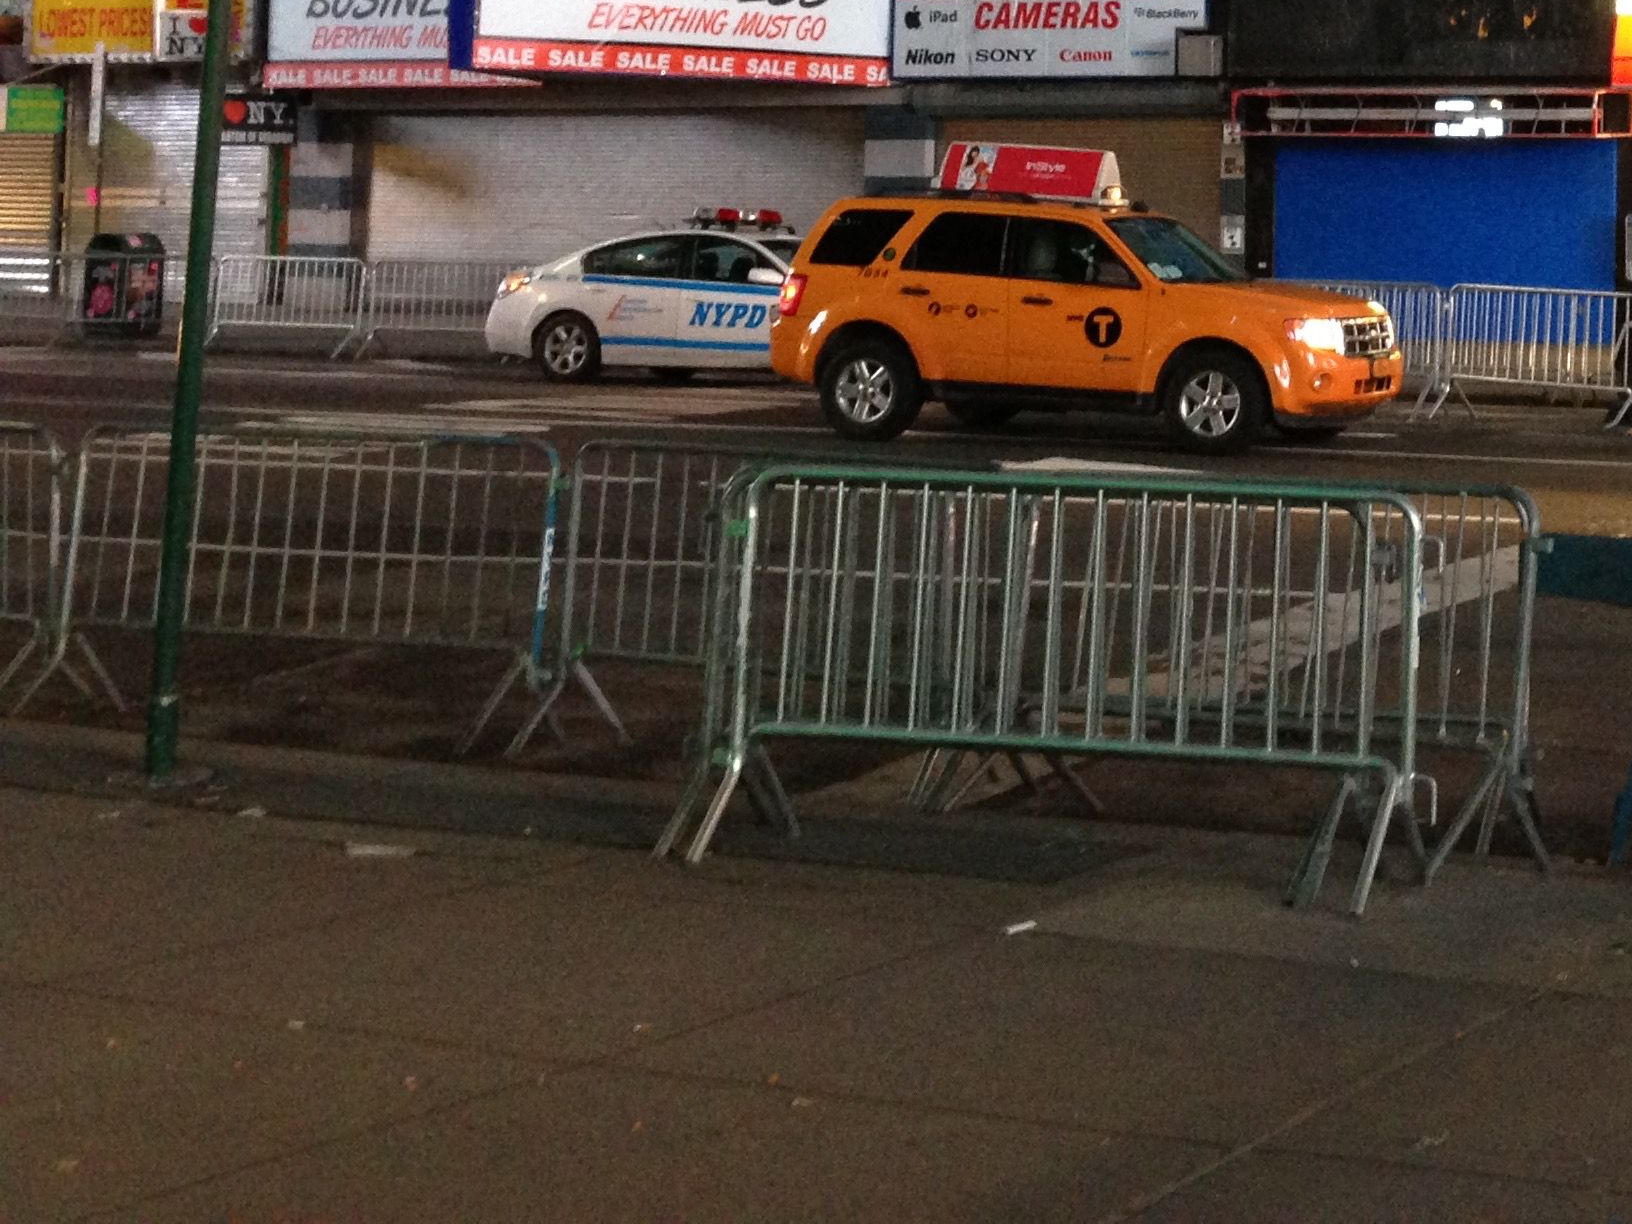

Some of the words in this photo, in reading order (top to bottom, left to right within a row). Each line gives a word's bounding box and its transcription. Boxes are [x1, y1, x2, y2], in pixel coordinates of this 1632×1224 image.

[38, 7, 96, 39] LOWEST
[587, 2, 730, 37] EVERYTHING
[732, 11, 798, 40] MUST
[795, 15, 828, 42] GO
[928, 10, 958, 23] iPad
[974, 0, 1121, 31] CAMERAS
[1145, 8, 1199, 21] BlackBerry
[311, 24, 415, 52] EVERYTHING
[477, 46, 537, 66] SALE
[548, 49, 605, 68] SALE
[616, 51, 672, 70] SALE
[682, 54, 736, 73] SALE
[745, 57, 797, 76] SALE
[807, 61, 856, 82] SALE
[904, 47, 956, 66] Nikon
[975, 48, 1037, 64] SONY
[1058, 48, 1113, 64] Canon
[269, 71, 306, 87] SALE
[311, 70, 352, 86] SALE
[360, 69, 398, 85] SALE
[404, 69, 443, 84] SALE
[688, 301, 767, 329] NYPD
